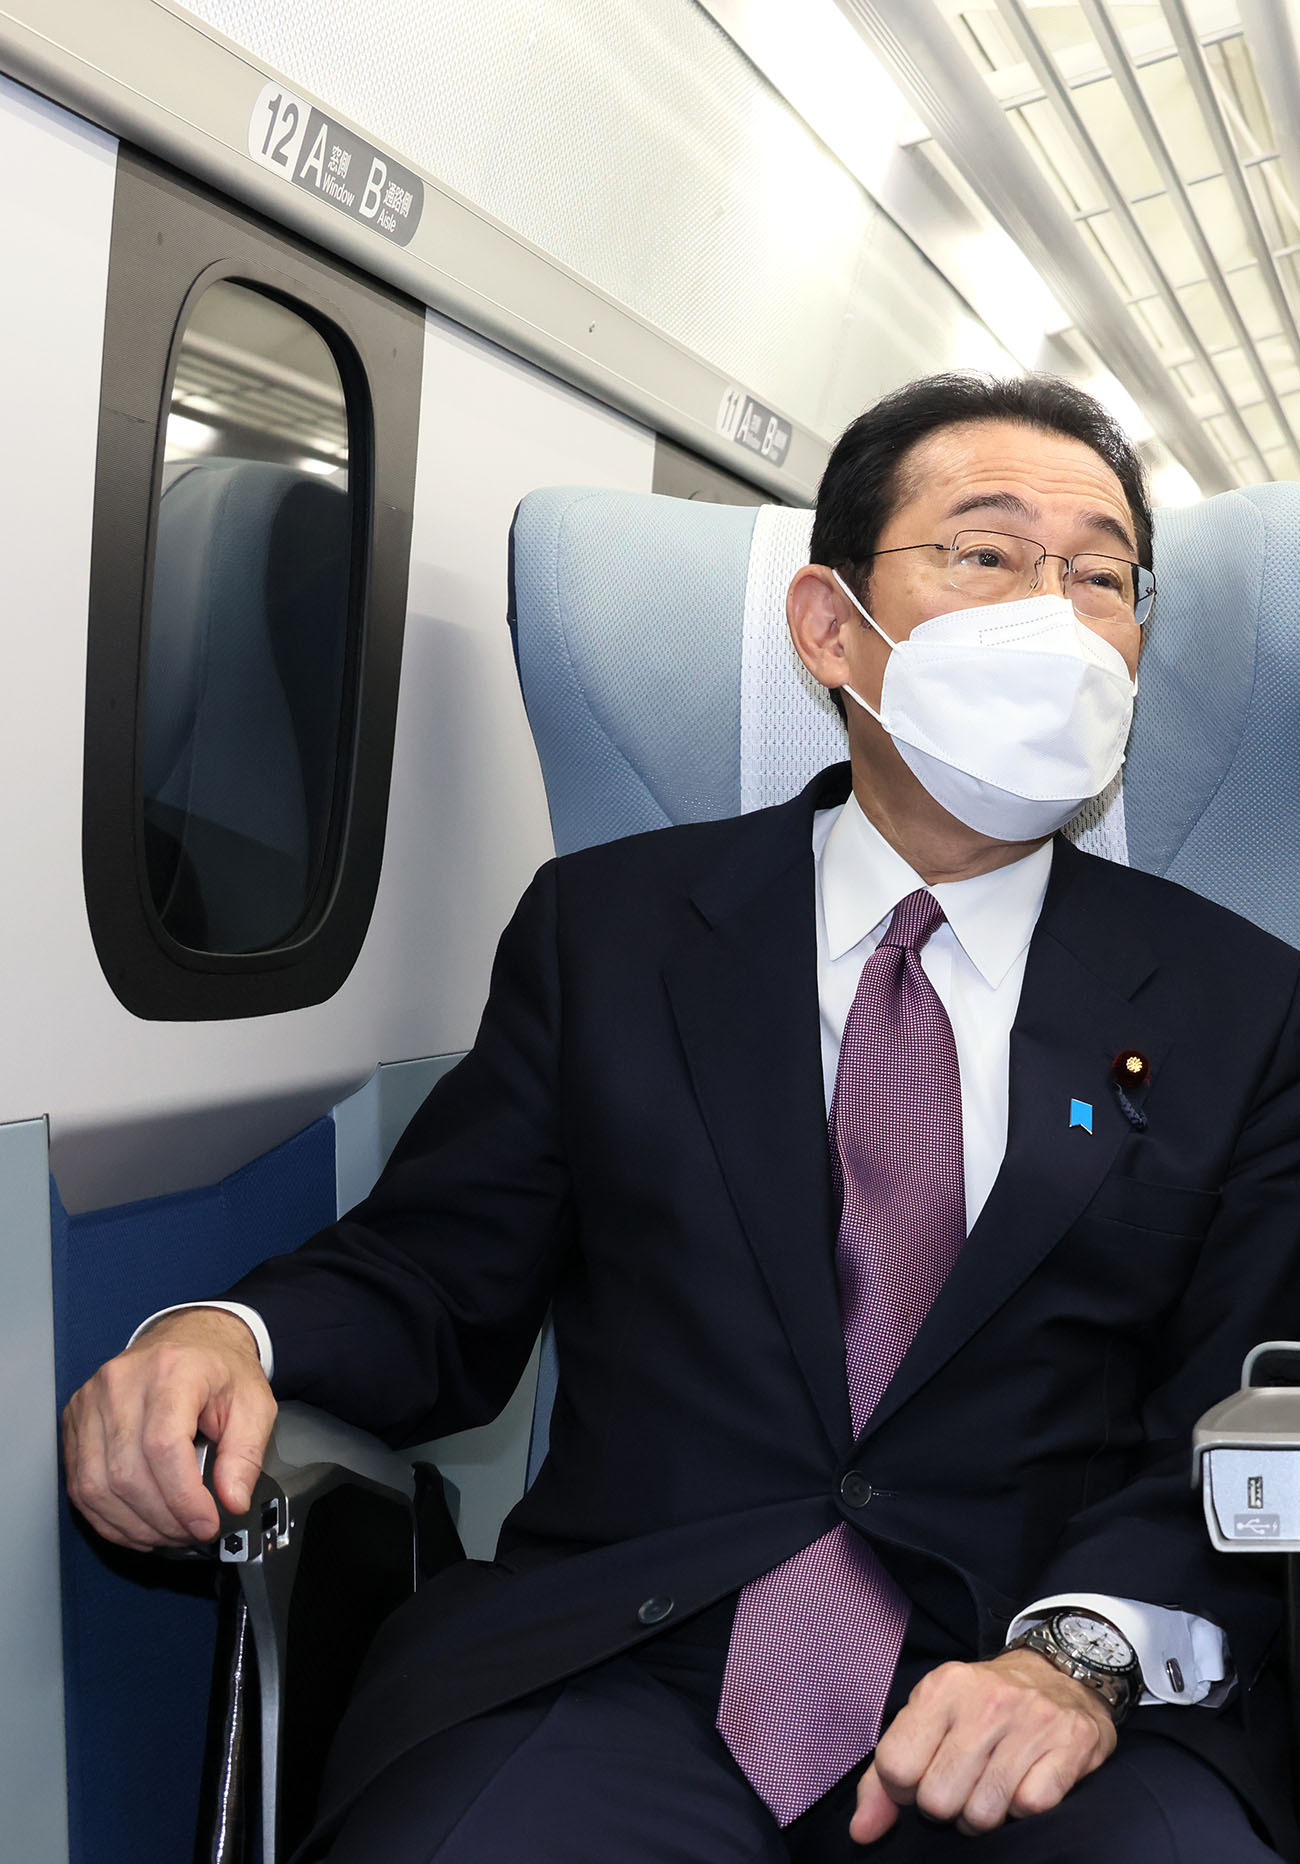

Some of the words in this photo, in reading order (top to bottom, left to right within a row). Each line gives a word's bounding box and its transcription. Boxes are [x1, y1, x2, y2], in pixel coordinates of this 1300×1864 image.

[262, 94, 300, 167] 12
[299, 123, 329, 188] A
[358, 157, 388, 218] B
[328, 145, 352, 179] 窓側
[322, 172, 355, 207] Window
[383, 181, 413, 218] 通路側
[377, 208, 397, 233] Aisle
[721, 391, 740, 433] 11
[737, 402, 754, 442] A
[761, 416, 778, 456] B
